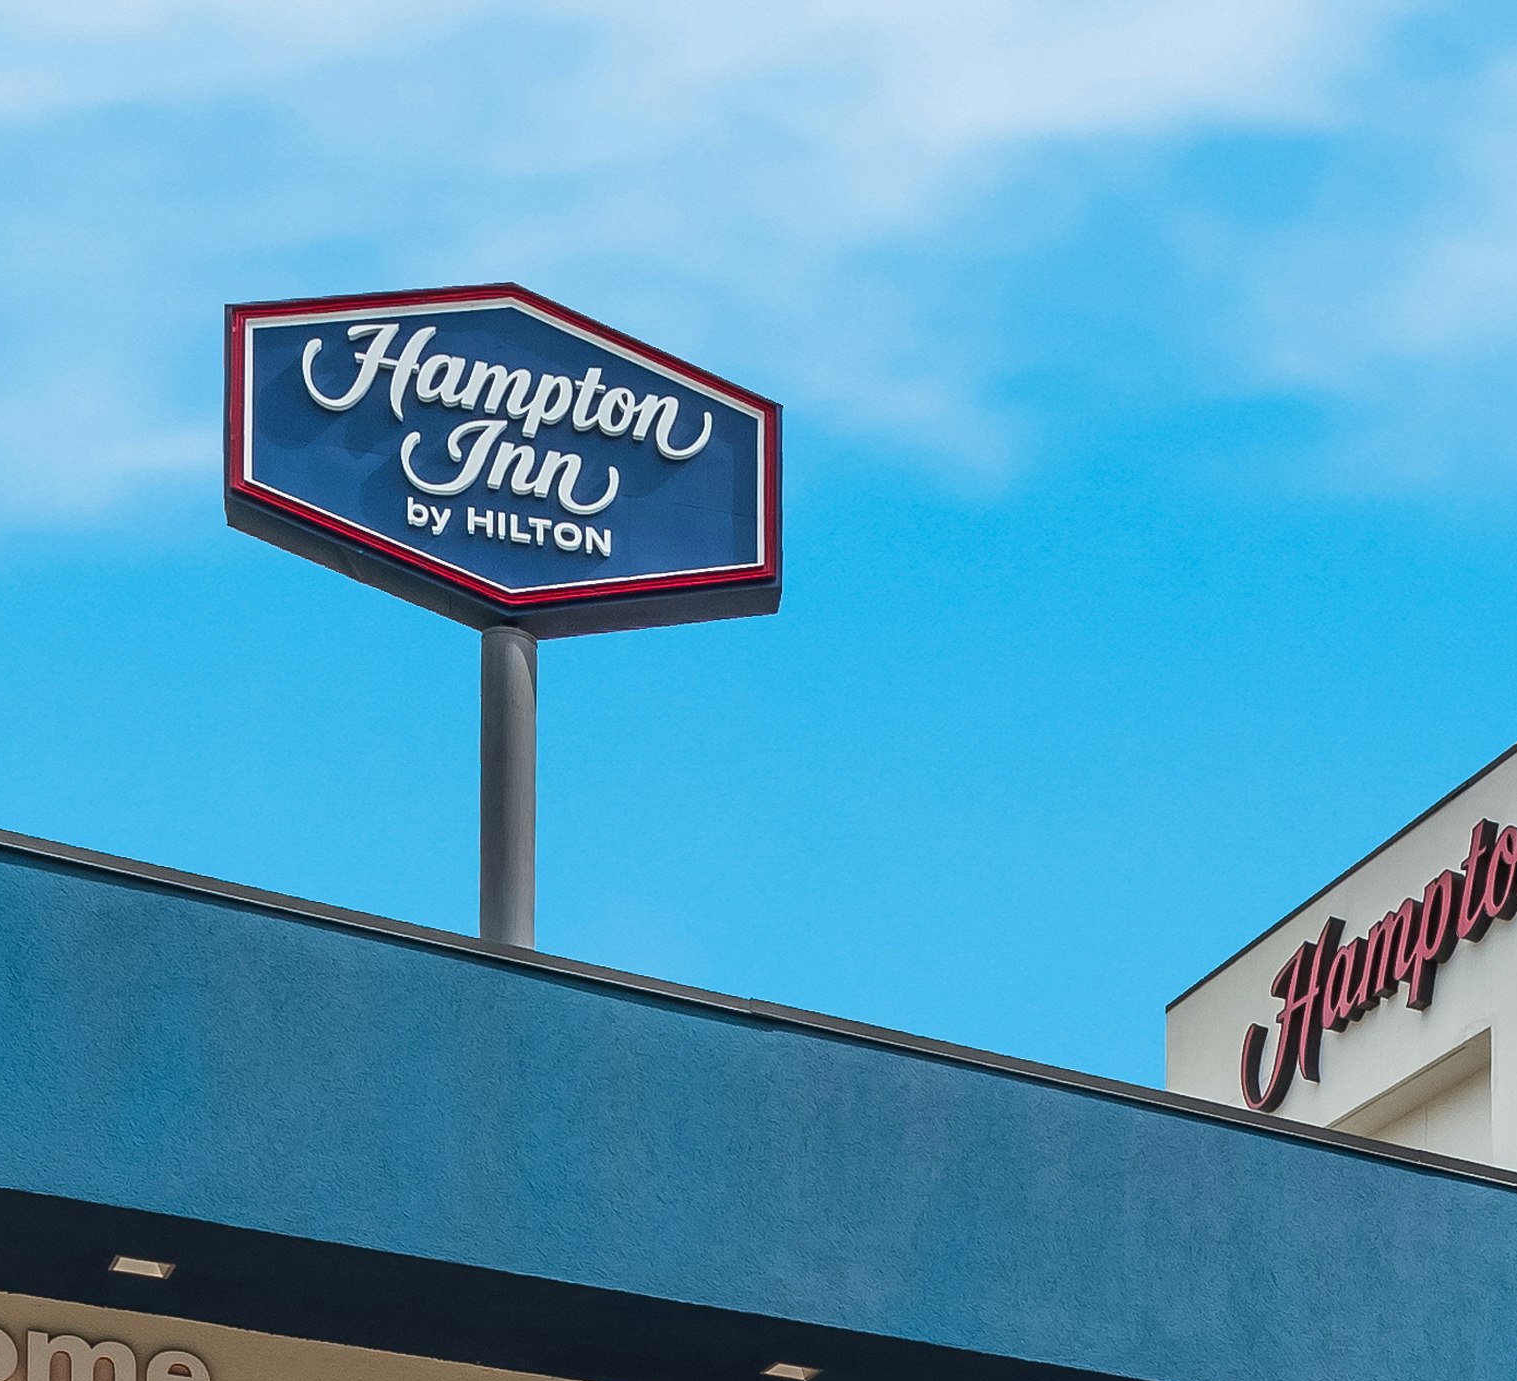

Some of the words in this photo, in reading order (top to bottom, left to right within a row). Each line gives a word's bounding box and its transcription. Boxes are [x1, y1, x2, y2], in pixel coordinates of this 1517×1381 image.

[302, 323, 712, 461] Hampton
[400, 419, 620, 515] Inn
[406, 496, 452, 536] by
[467, 504, 613, 558] HILTON
